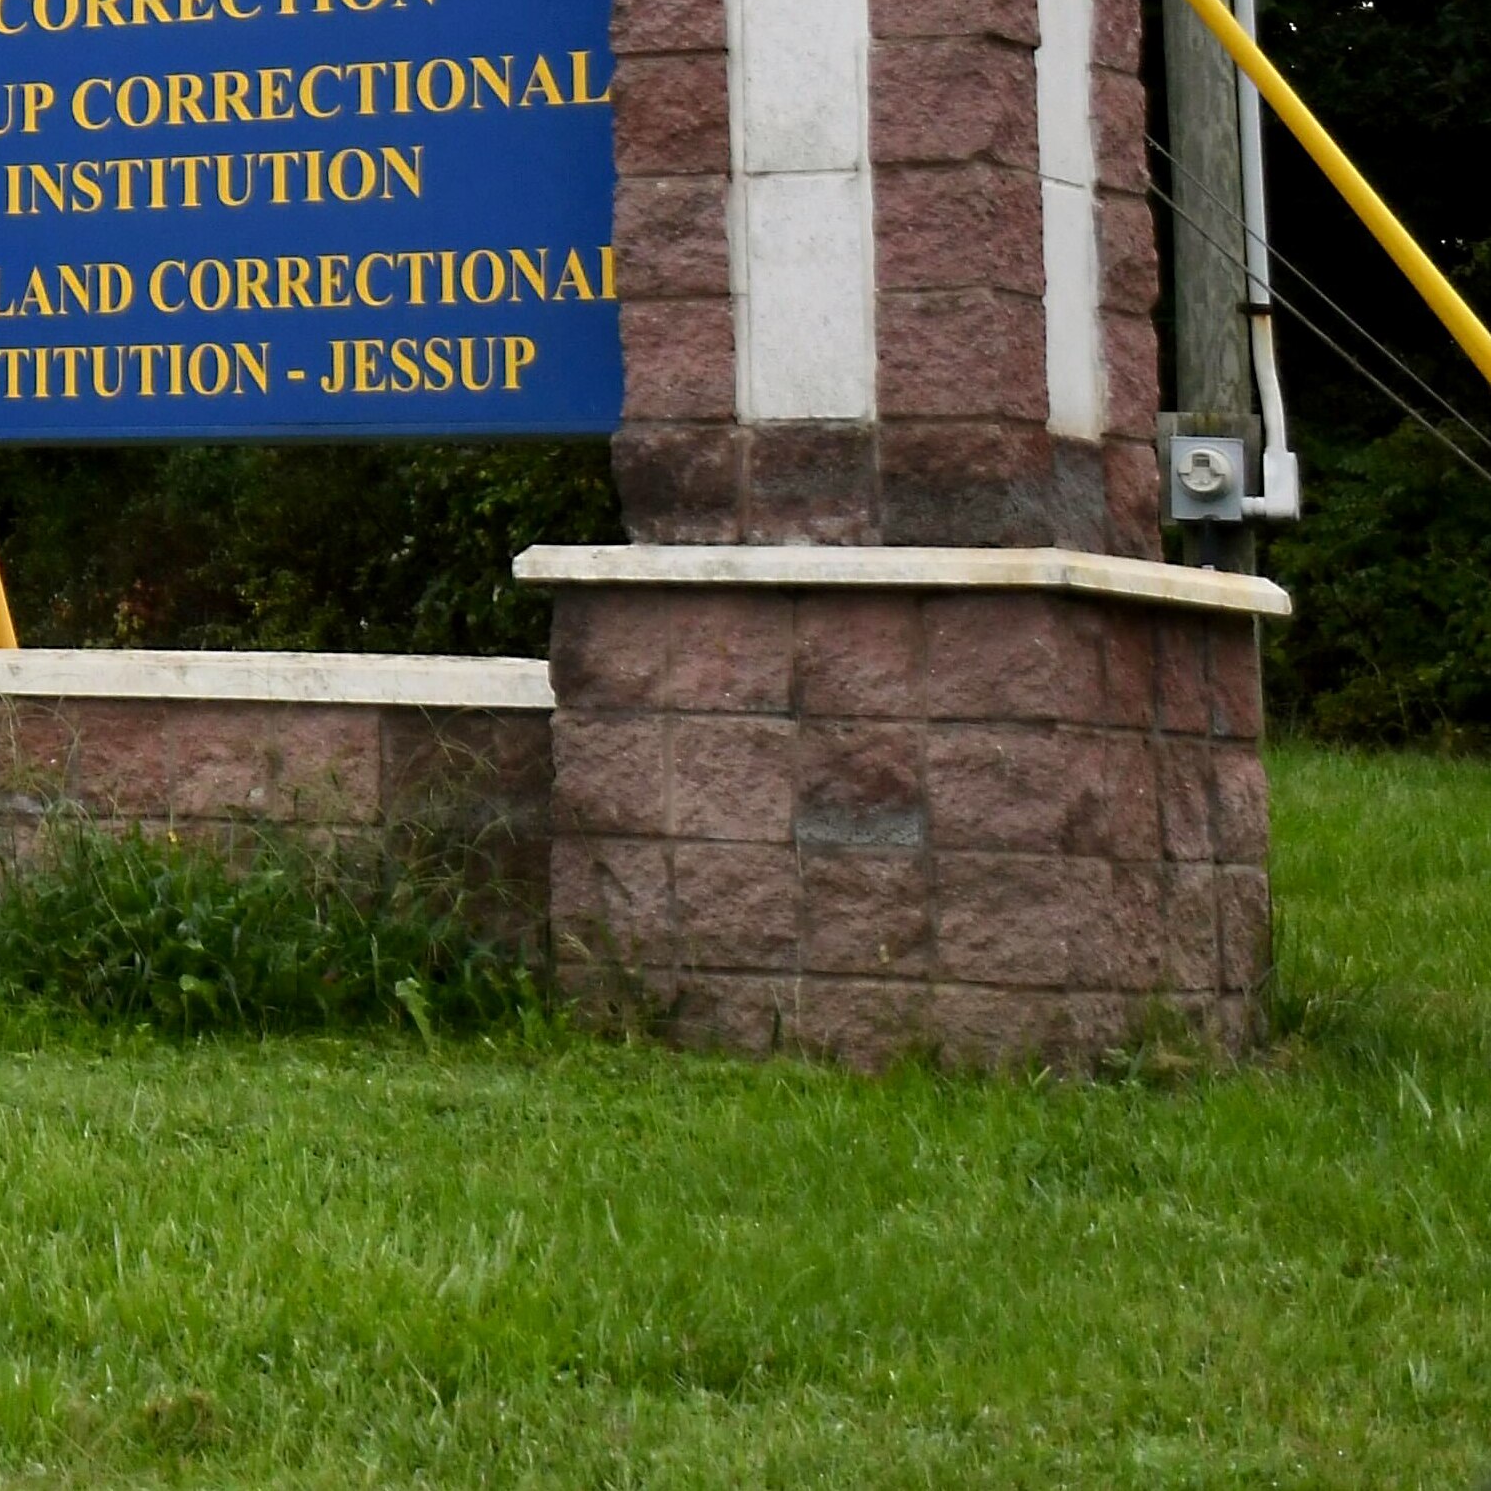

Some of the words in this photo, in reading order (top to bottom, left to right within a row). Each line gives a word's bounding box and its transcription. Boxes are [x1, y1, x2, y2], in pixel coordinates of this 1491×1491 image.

[70, 50, 611, 133] CORRECTIONAL
[3, 145, 424, 216] INSTITUTION
[287, 367, 306, 382] -
[320, 335, 536, 394] JESSUP
